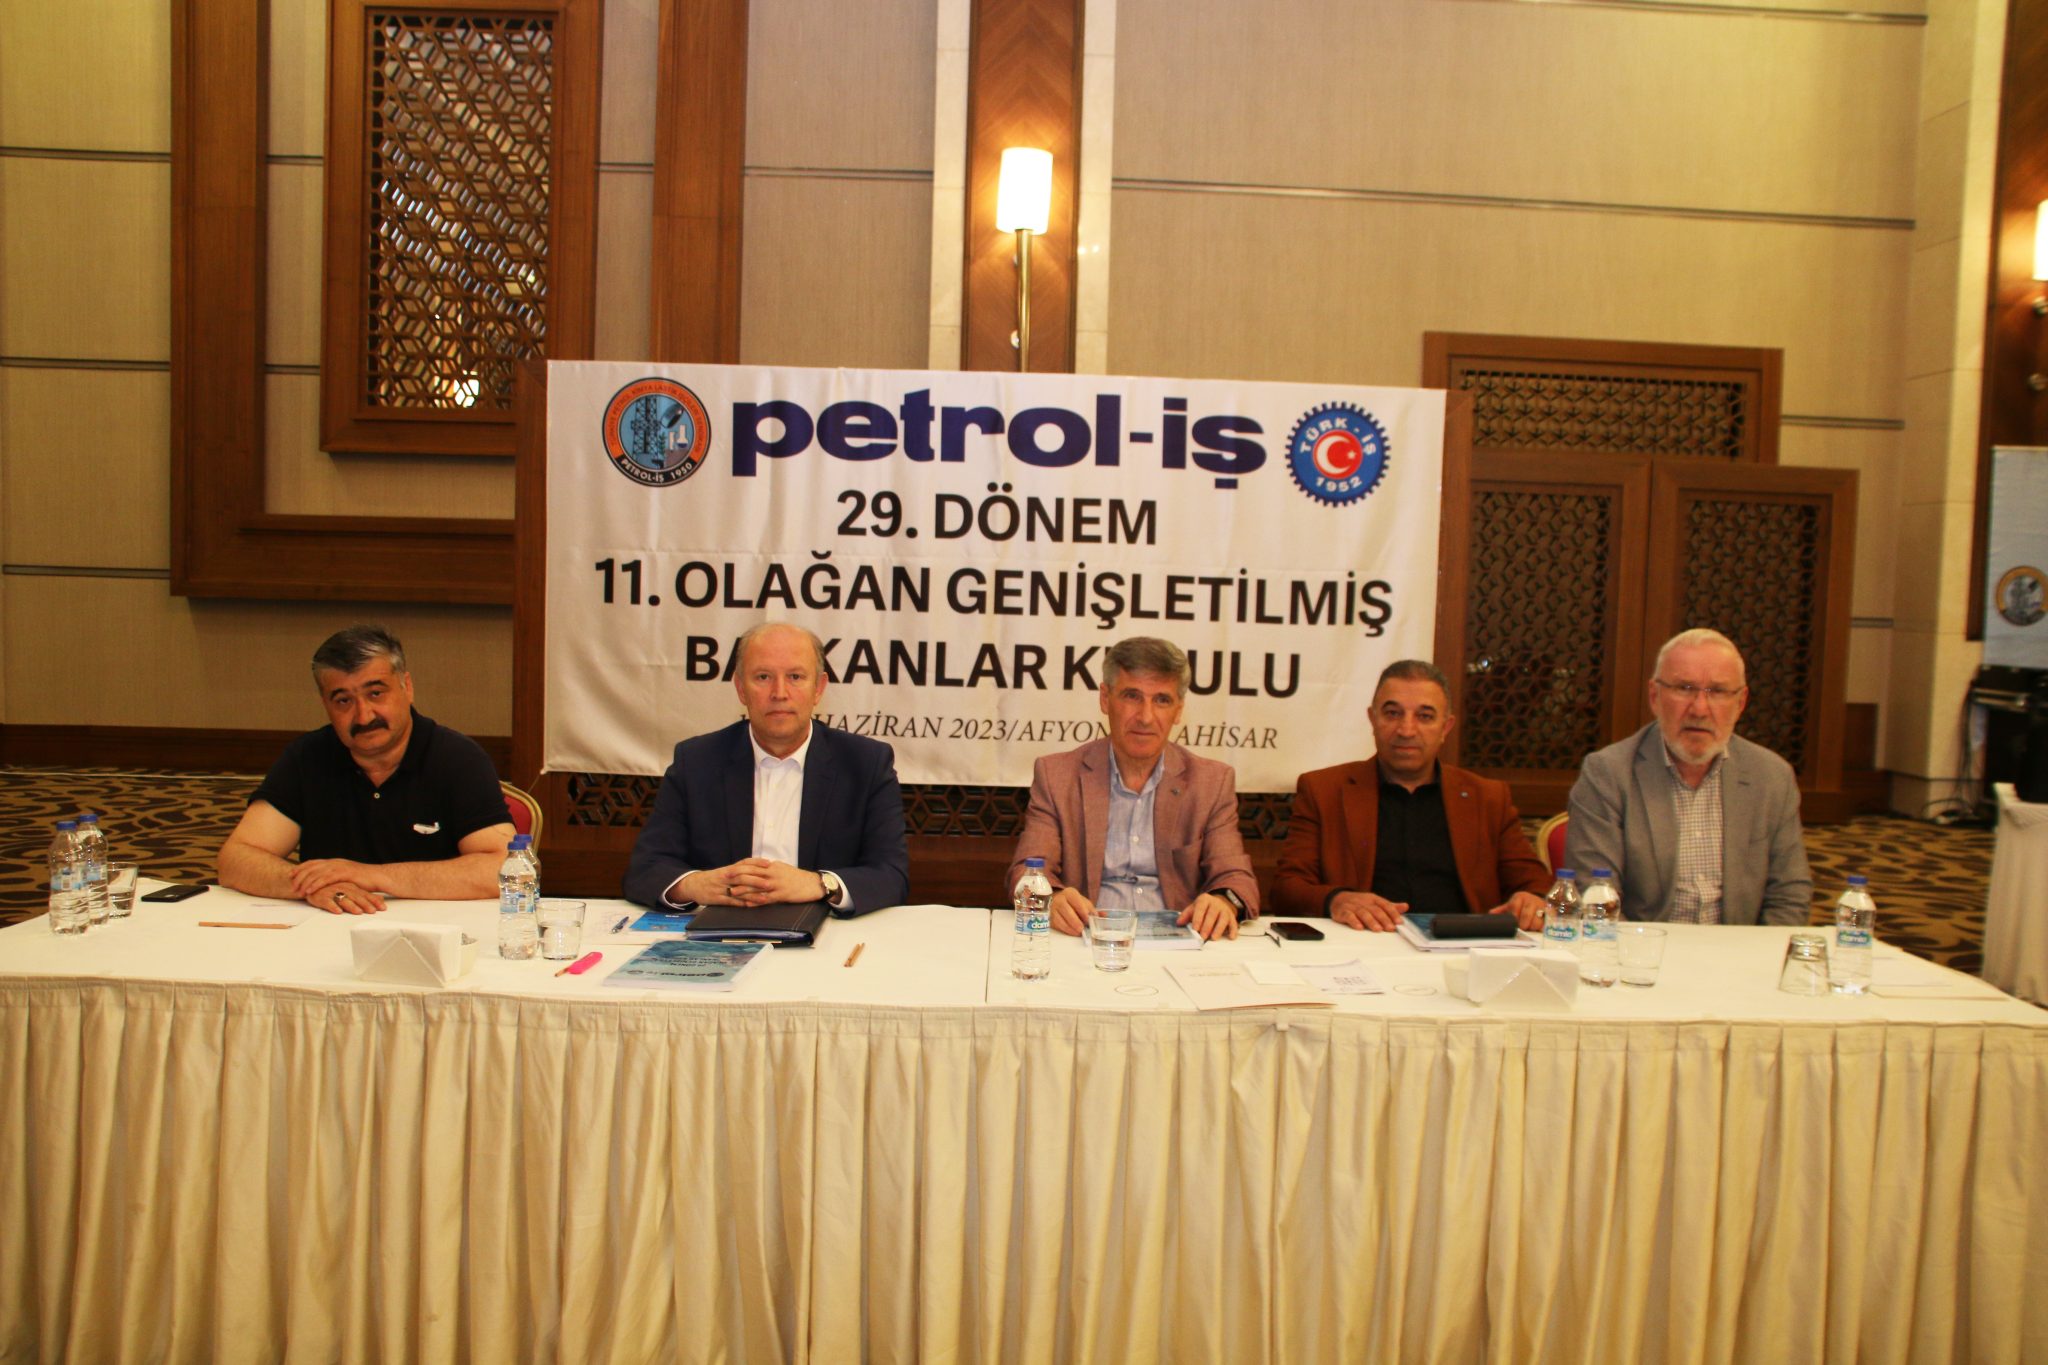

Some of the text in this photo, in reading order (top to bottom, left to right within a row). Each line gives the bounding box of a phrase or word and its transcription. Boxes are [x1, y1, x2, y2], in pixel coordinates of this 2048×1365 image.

[671, 462, 692, 479] 1950
[731, 388, 1267, 490] petrol-iş
[837, 481, 1157, 545] 29. DÖNEM
[1316, 475, 1362, 492] 1952
[594, 550, 1392, 638] 11. OLAĞAN GENİŞLETİLMİŞ
[685, 635, 1300, 699] BKANLAR KULU
[949, 714, 1278, 749] 2023/AFYONAHİSAR
